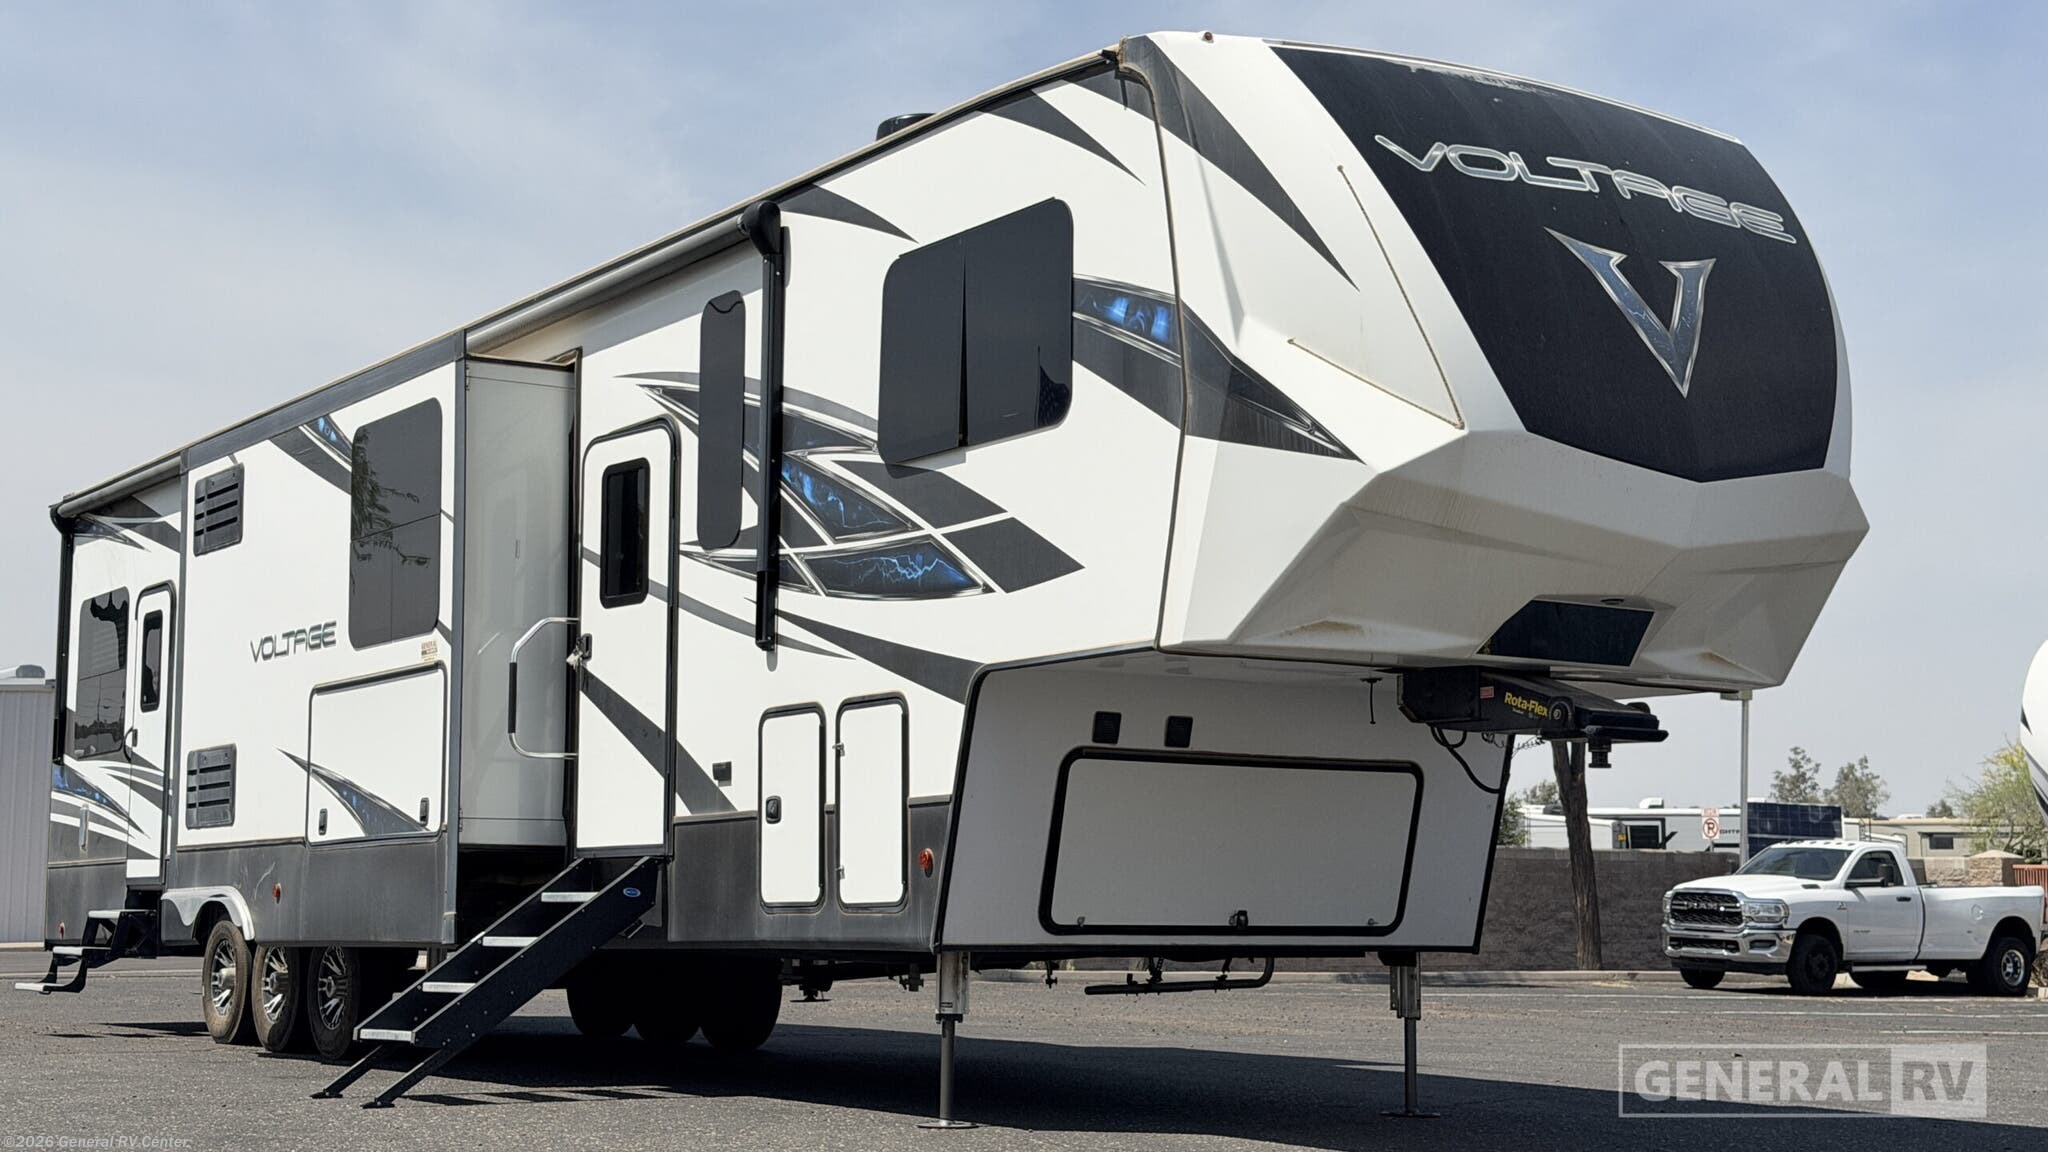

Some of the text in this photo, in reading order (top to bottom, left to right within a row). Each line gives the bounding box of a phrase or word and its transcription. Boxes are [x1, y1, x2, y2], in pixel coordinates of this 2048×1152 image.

[1374, 134, 1797, 244] VOLTAGE
[1544, 226, 1716, 399] V
[250, 620, 337, 663] VOLTAGE
[1686, 902, 1718, 910] RAM
